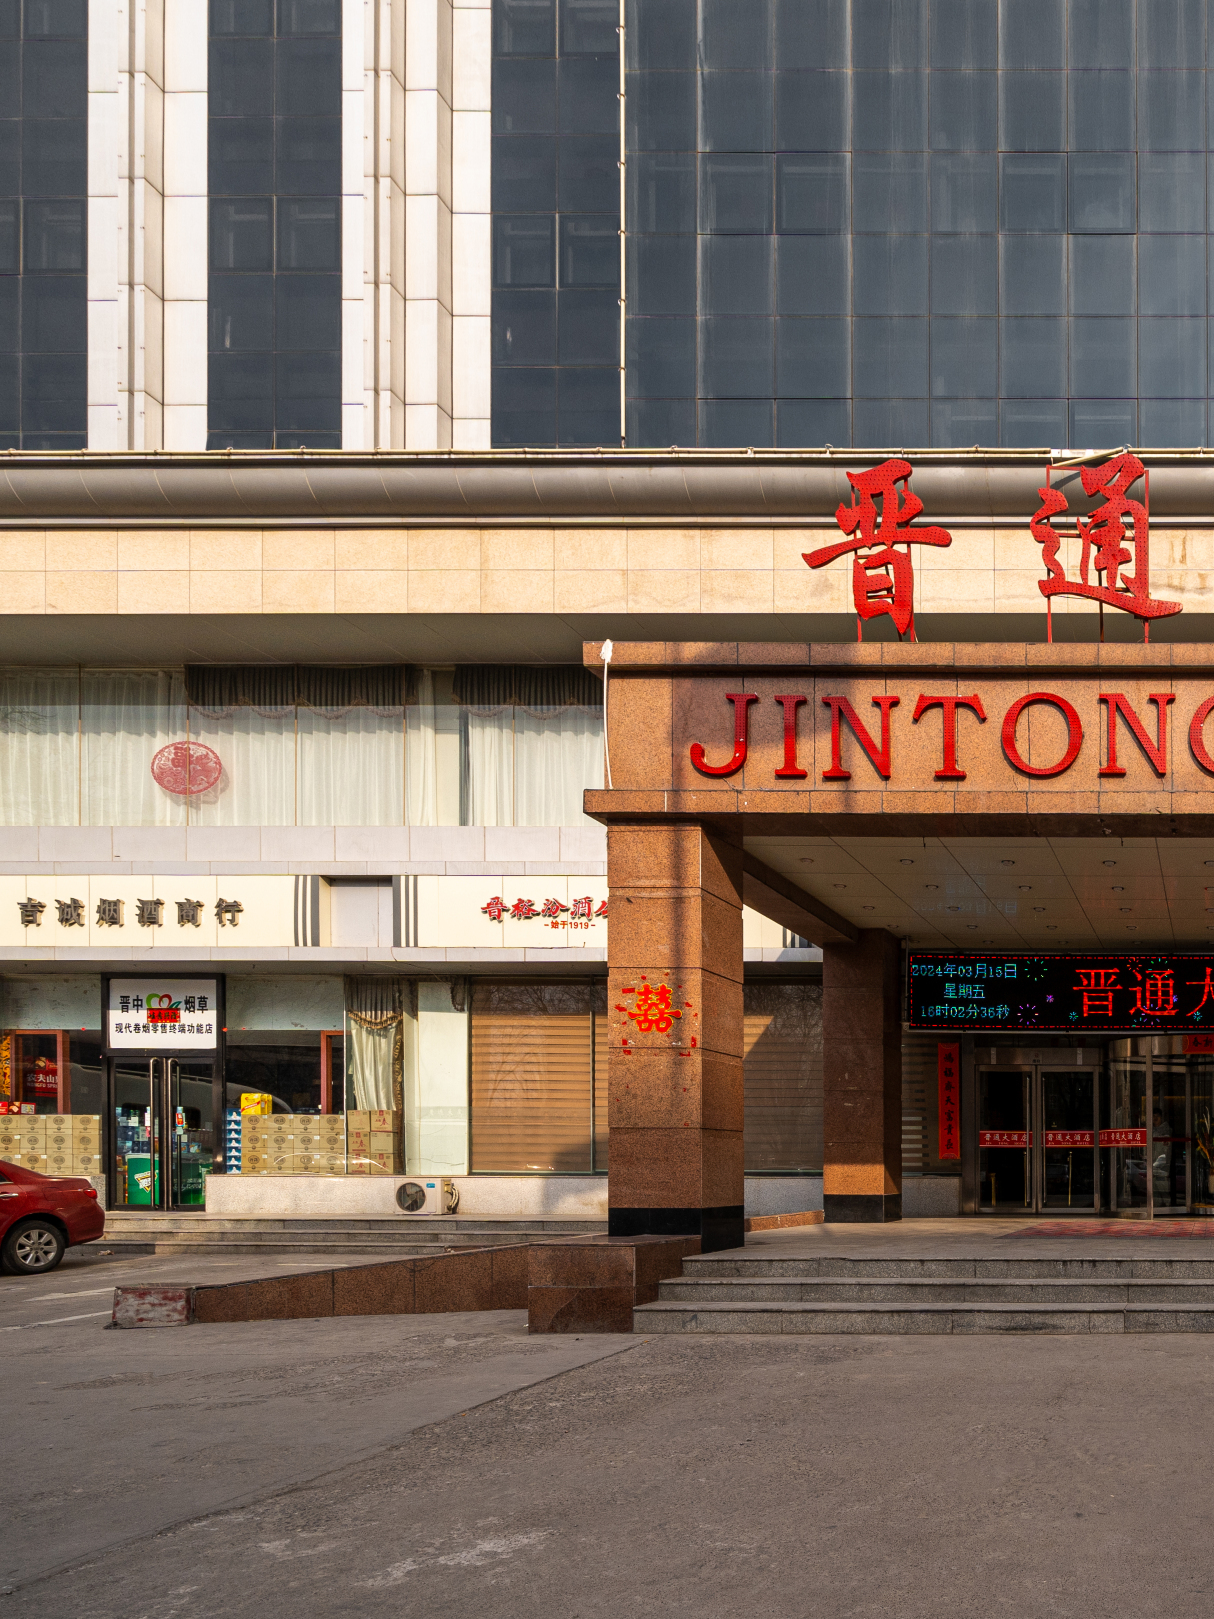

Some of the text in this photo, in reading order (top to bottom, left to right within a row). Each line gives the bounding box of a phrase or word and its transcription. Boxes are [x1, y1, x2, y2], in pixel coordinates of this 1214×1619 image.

[16, 897, 244, 928] 吉诚烟酒商行
[911, 963, 1017, 979] 2024年03月15日
[943, 983, 986, 999] 星期五
[119, 995, 209, 1014] 晋中 烟草
[921, 1003, 1010, 1020] 16时02分36秒
[114, 1023, 213, 1035] 现代卷烟零售终端功能店
[26, 1073, 57, 1083] 农夫山
[1046, 1133, 1091, 1142] 晋通大酒店
